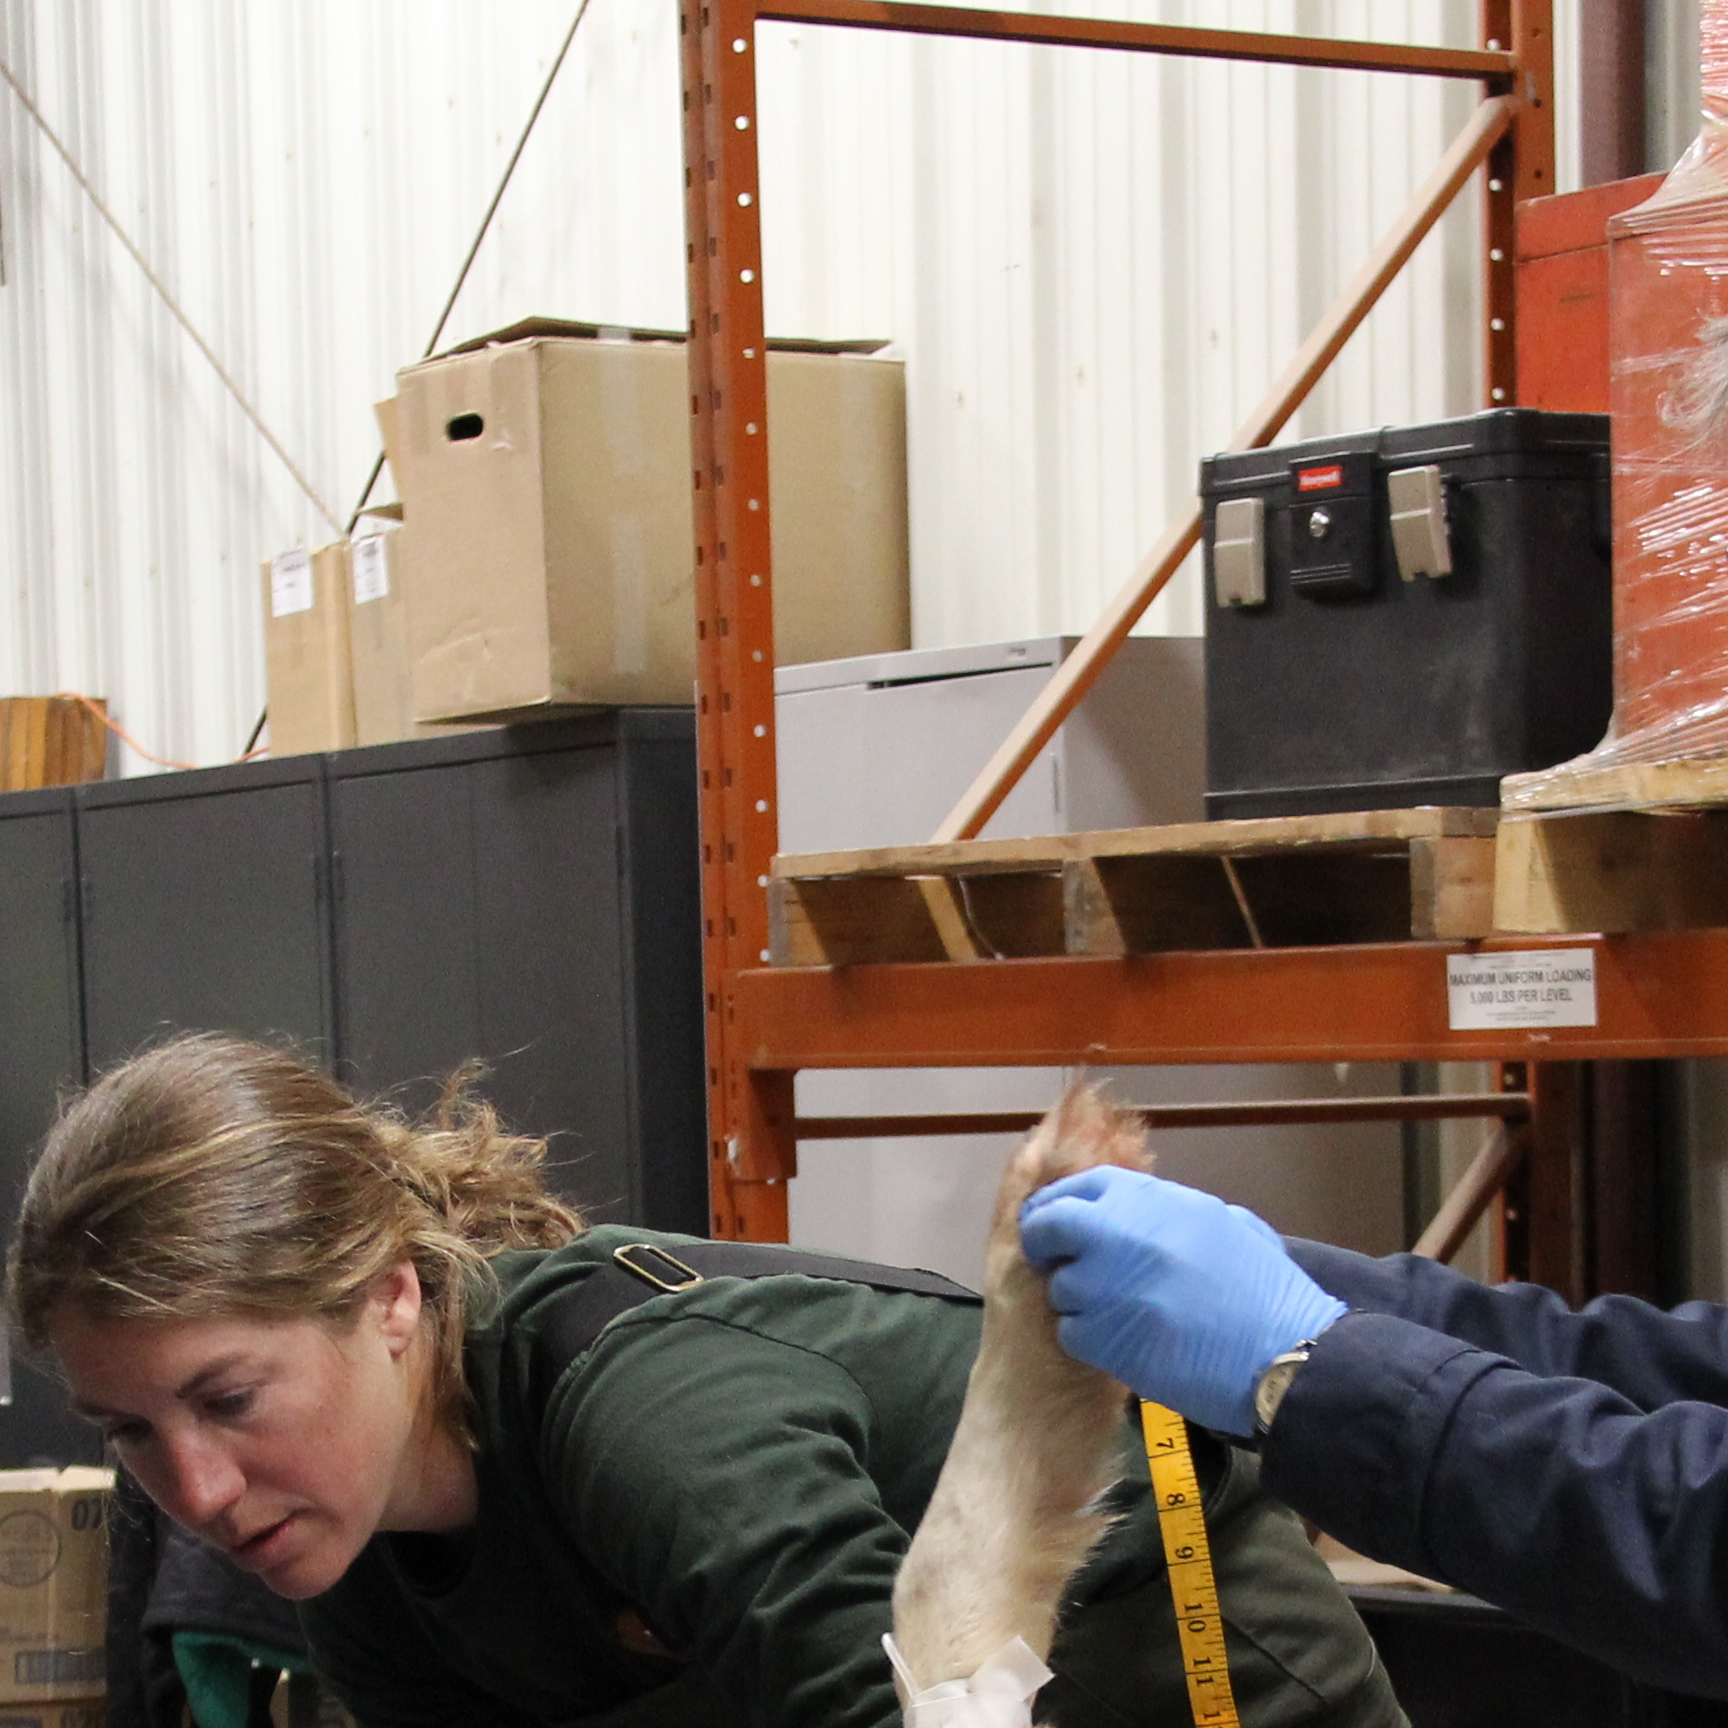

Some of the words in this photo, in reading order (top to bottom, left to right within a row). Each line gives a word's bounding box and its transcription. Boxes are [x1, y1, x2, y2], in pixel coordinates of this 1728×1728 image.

[1449, 973, 1496, 986] MAXIMUM
[1499, 971, 1543, 984] UNIFORM
[1546, 969, 1592, 982] LOADING
[1518, 989, 1538, 1002] PER
[1541, 987, 1572, 1001] LEVEL
[1156, 1438, 1175, 1449] 7
[1166, 1492, 1186, 1506] 8
[1176, 1546, 1194, 1559] 9
[1184, 1603, 1207, 1633] 10
[1193, 1657, 1214, 1686] 11
